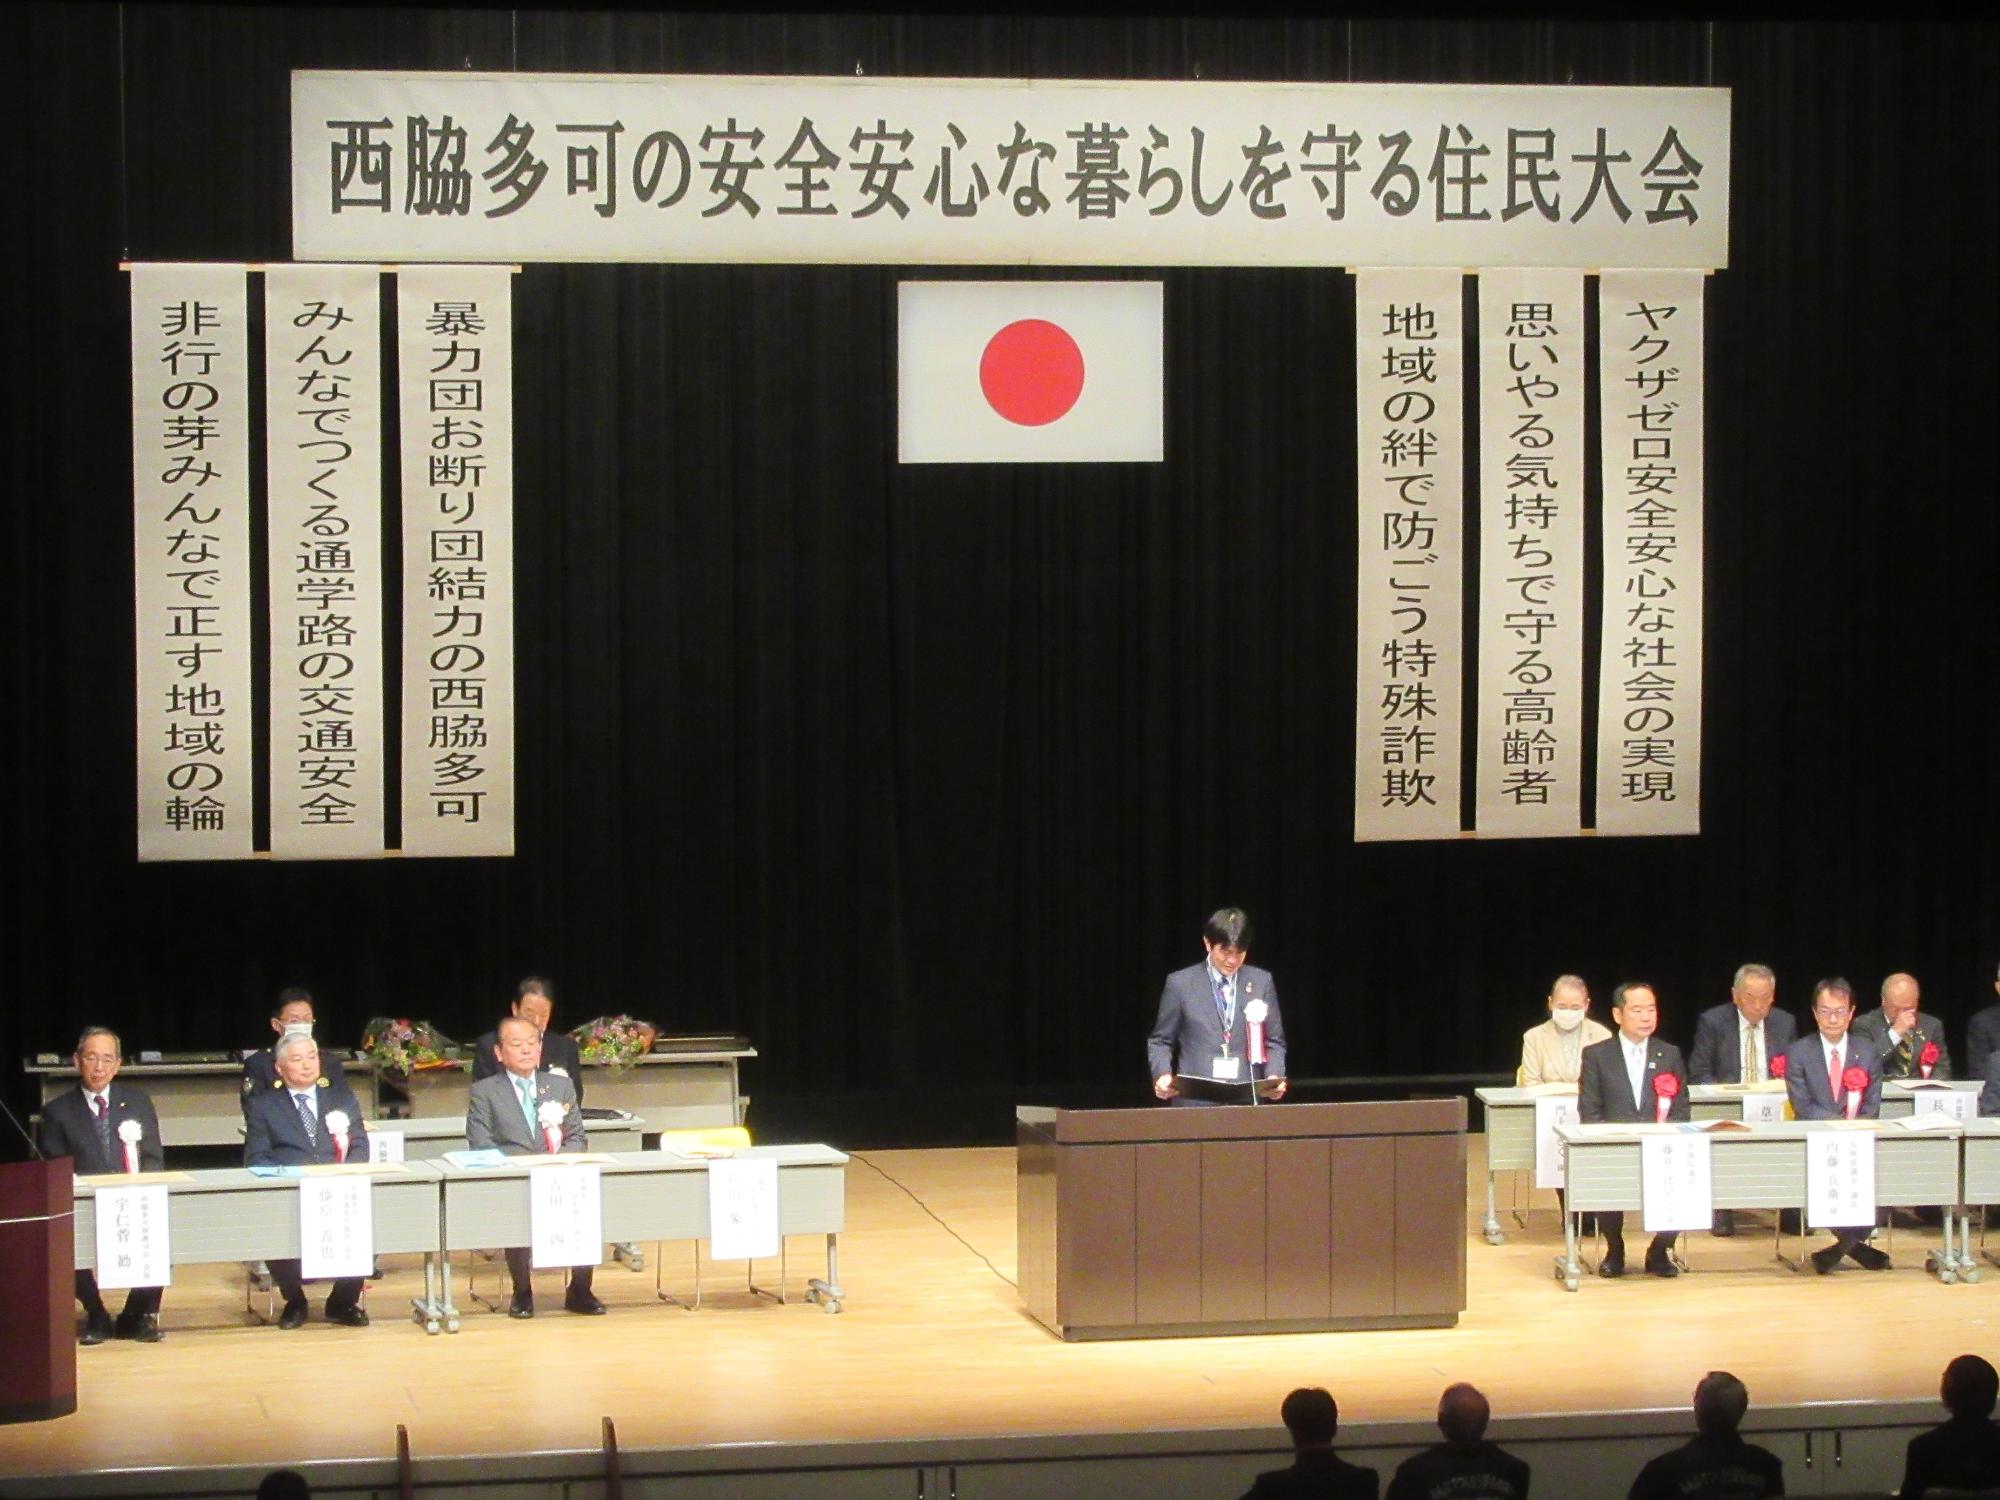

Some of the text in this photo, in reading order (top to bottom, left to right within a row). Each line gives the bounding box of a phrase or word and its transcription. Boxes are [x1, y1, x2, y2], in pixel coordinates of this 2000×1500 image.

[326, 113, 1704, 226] 西脇多可の安全安心な暮らしを守る住民大会
[160, 301, 225, 832] 非行の芽みんなで正す地域の輪
[293, 301, 358, 825] みんなでつくる通学路の交通安全
[426, 302, 488, 823] 暴力団お断り団結力の西脇多可
[1380, 302, 1439, 808] 地域の絆で防ごう特殊詐欺
[1501, 303, 1559, 806] 思いやる気持ちで守る高齢者
[1621, 302, 1680, 802] ヤクザゼロ安全安心な社会の実現
